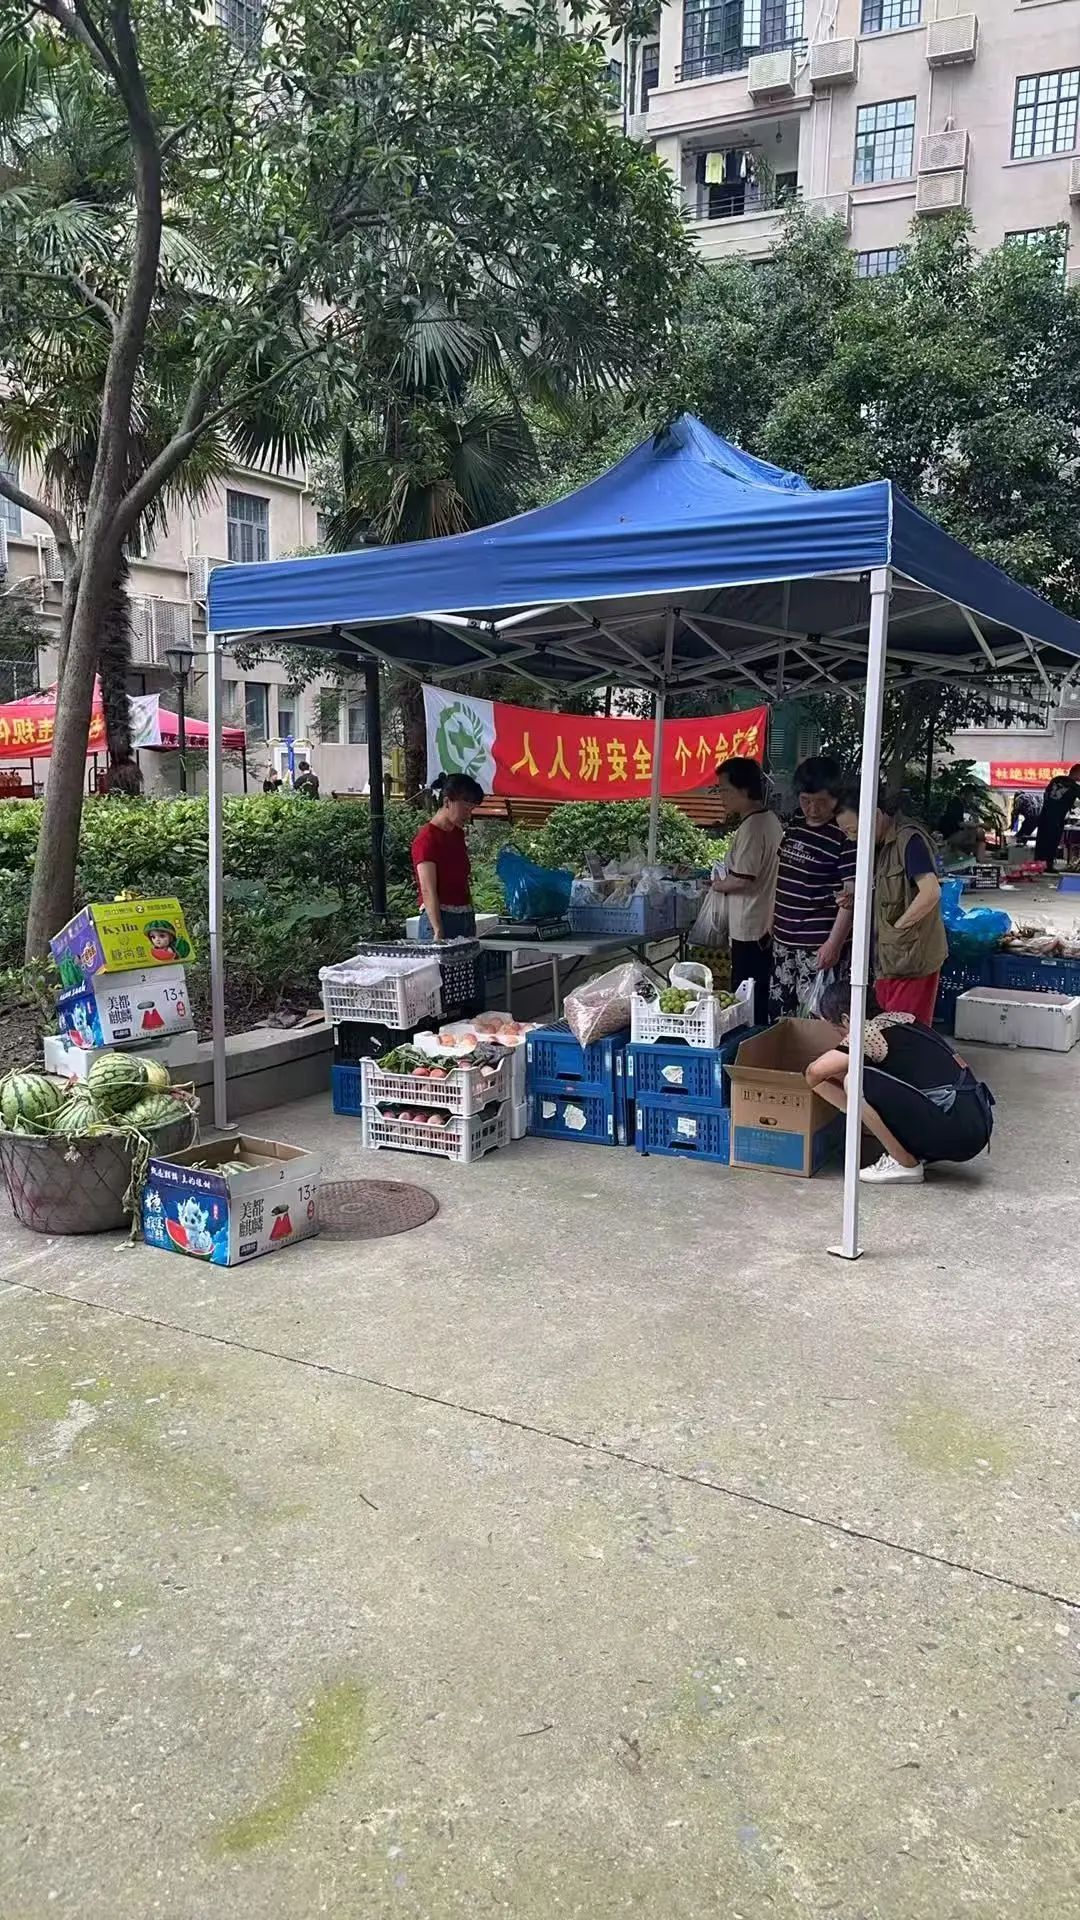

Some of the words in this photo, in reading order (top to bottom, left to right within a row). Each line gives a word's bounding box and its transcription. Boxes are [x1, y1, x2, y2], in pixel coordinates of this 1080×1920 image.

[510, 731, 653, 782] 人人讲安全
[140, 974, 147, 982] 2
[107, 994, 131, 1011] 美都
[163, 987, 185, 1001] 13+
[279, 1170, 285, 1180] 2
[297, 1184, 317, 1202] 13+
[239, 1198, 265, 1222] 美都
